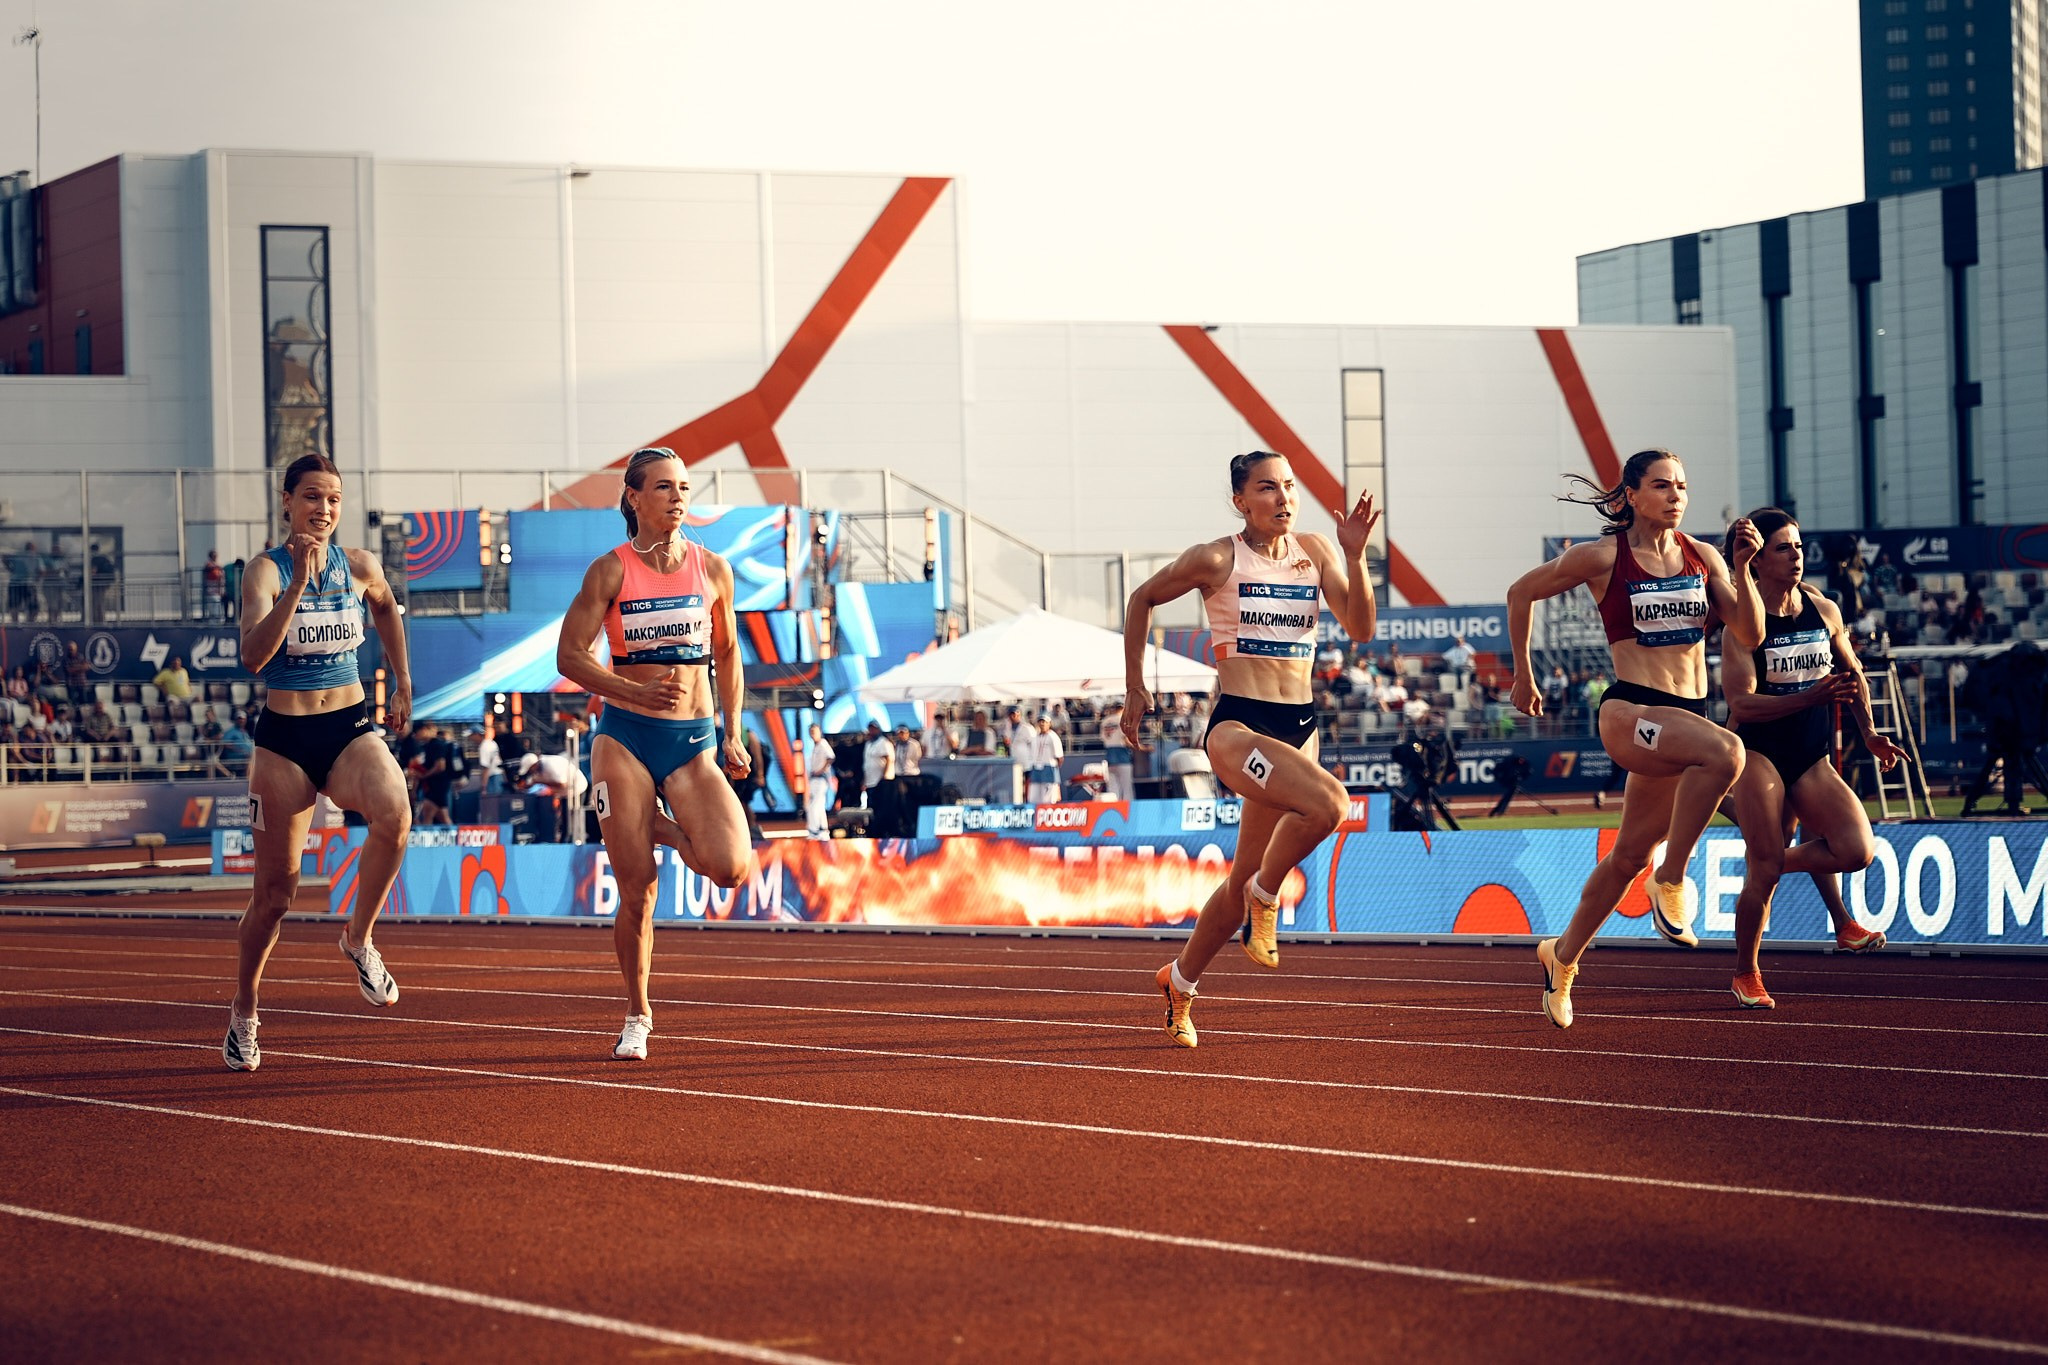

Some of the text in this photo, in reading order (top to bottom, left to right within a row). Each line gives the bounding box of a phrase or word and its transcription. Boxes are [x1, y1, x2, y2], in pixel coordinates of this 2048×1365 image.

[1252, 586, 1271, 595] ПСБ
[298, 602, 315, 610] ПСБ
[632, 601, 652, 611] ПСБ
[1635, 600, 1707, 621] КАРАВАЕВА
[1239, 610, 1314, 629] МАКСИМОВА В.
[298, 622, 358, 644] ОСИПОВА
[624, 622, 691, 642] МАКСИМОВА
[1773, 636, 1791, 645] ПСБ
[1639, 728, 1656, 746] 4
[1248, 757, 1266, 780] 5
[1459, 759, 1496, 784] ПС
[249, 798, 259, 823] 7
[596, 789, 605, 814] 6
[963, 809, 1035, 829] ЧЕМПИОНАТ
[1036, 808, 1088, 827] РОССИИ
[1185, 806, 1212, 823] ПСБ
